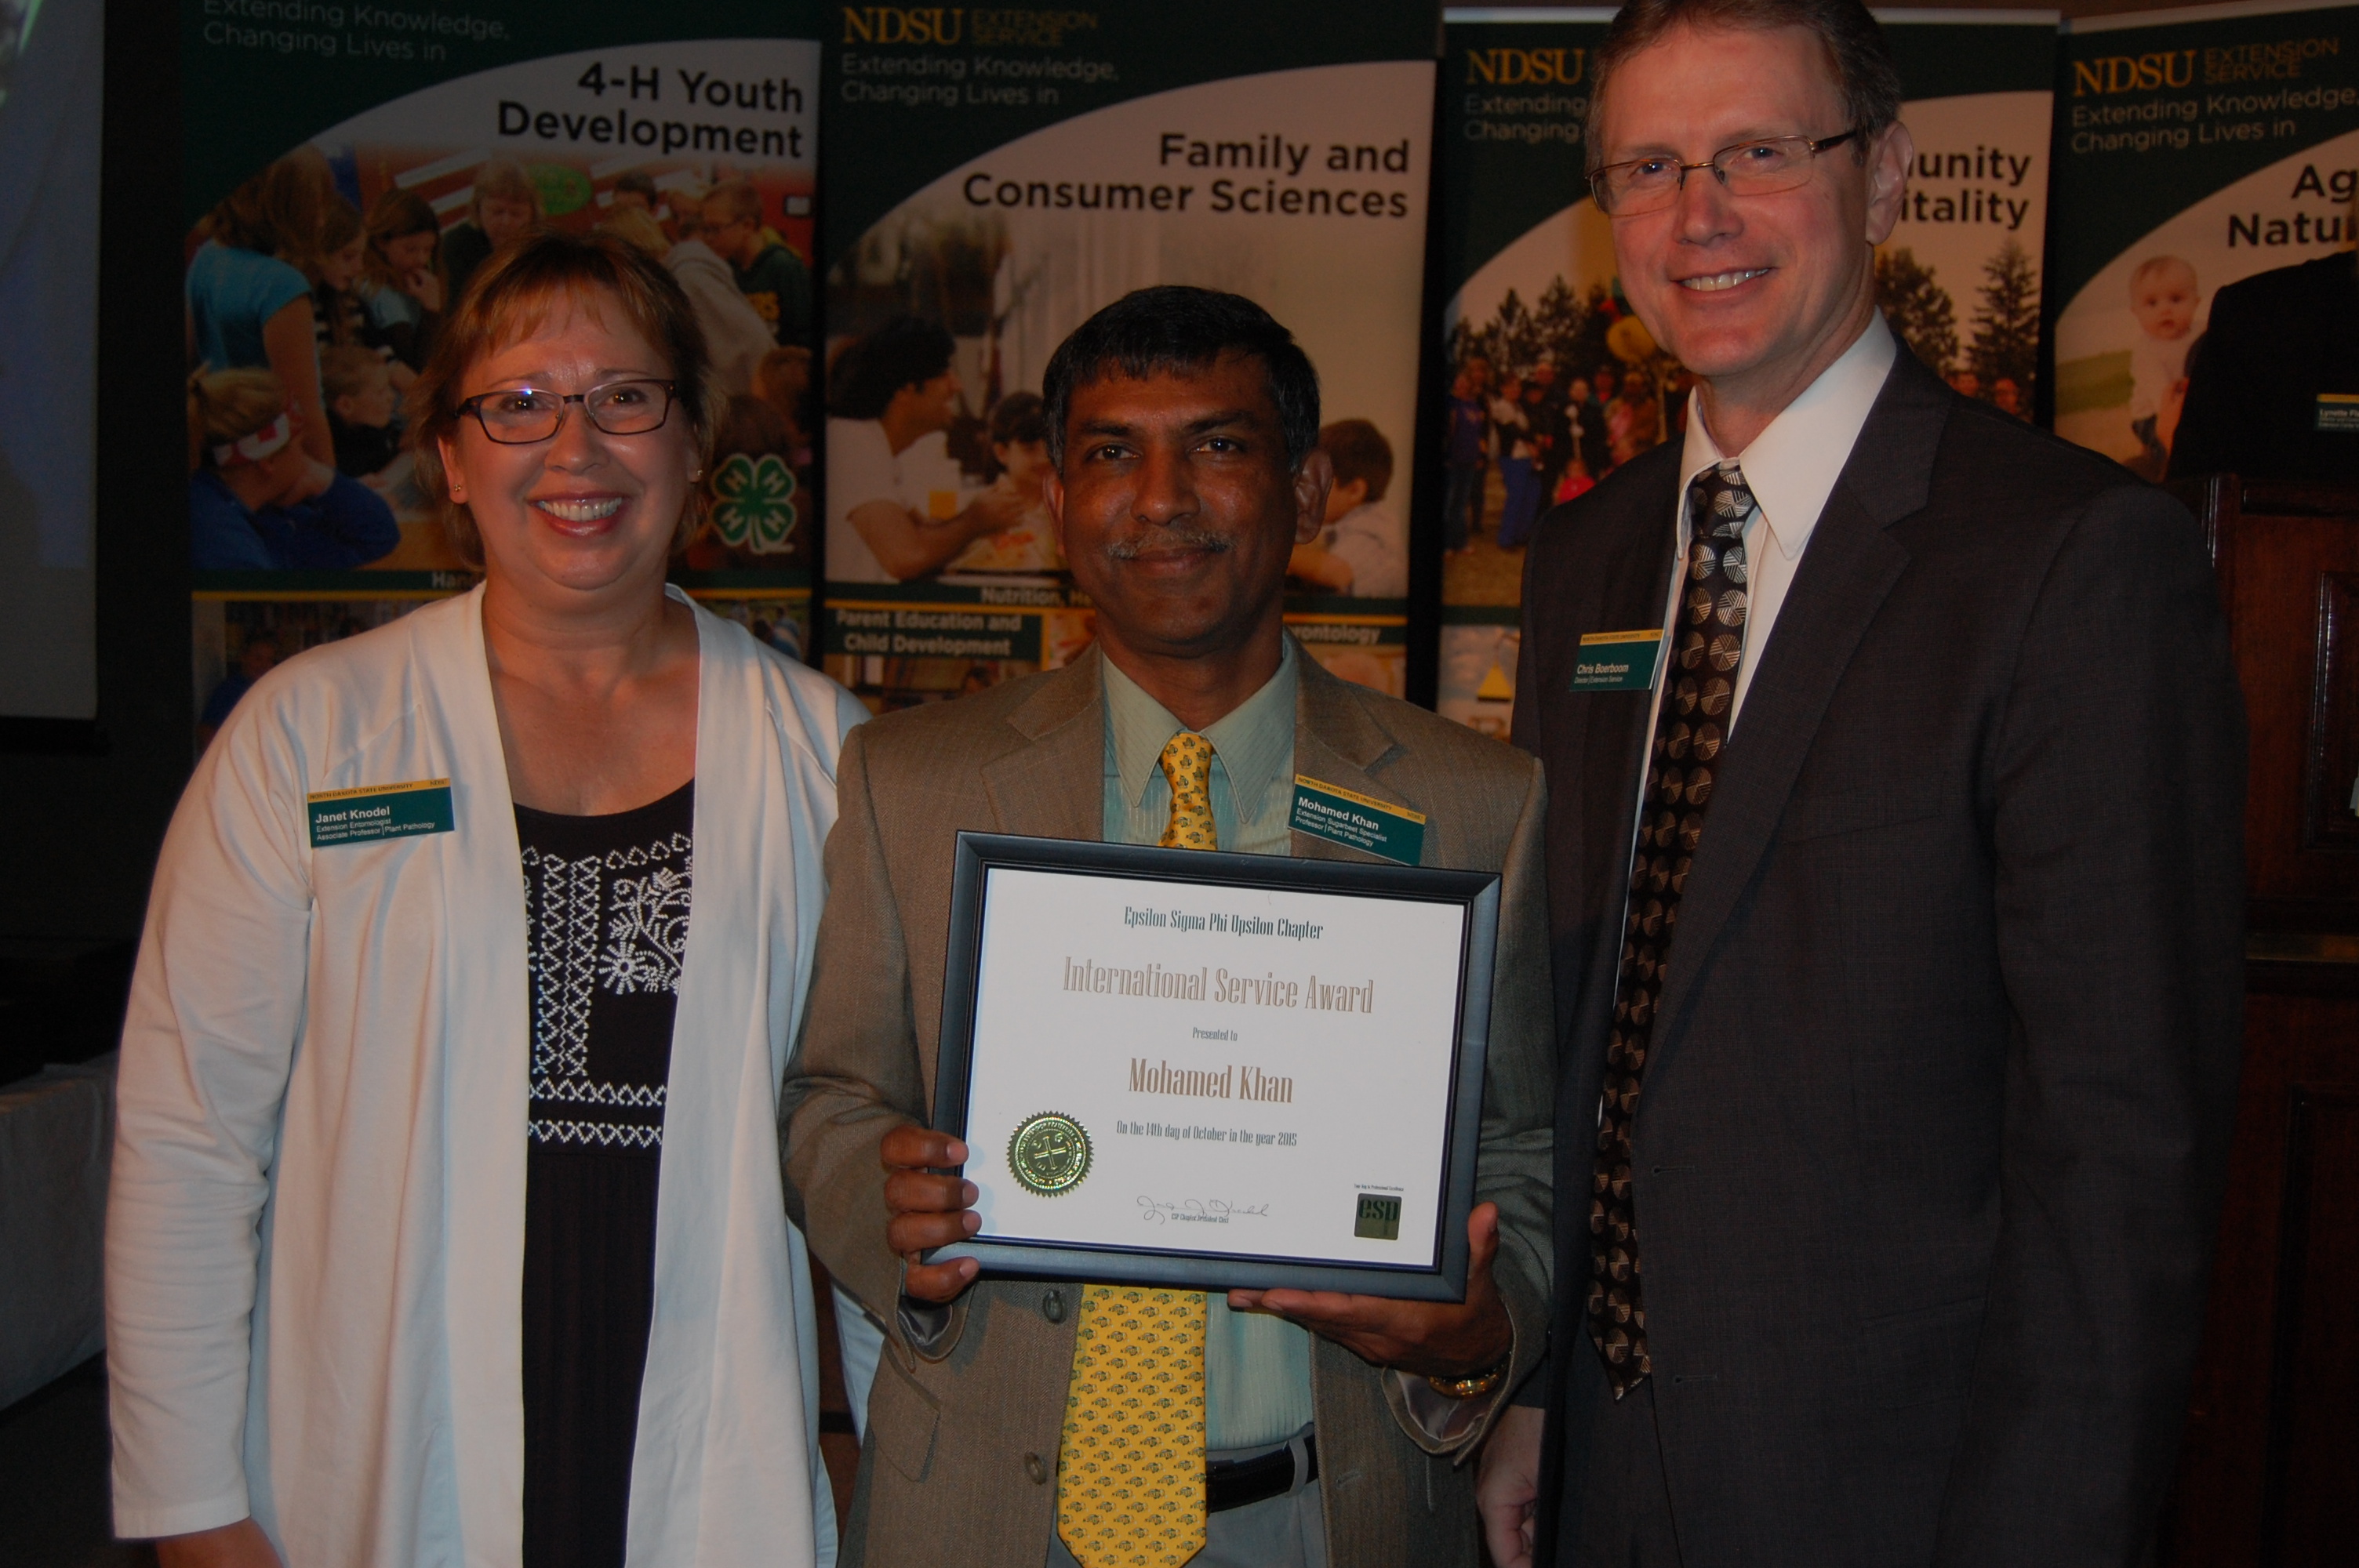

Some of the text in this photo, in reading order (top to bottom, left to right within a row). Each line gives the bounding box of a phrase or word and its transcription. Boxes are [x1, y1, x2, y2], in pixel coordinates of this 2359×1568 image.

[842, 6, 965, 45] NDSU
[203, 20, 447, 63] Changing Lives in
[841, 52, 969, 82] Extending
[1465, 47, 1586, 85] NDSU
[2071, 37, 2341, 97] NDSU EXTENSION
[2205, 60, 2302, 85] SERVICE
[577, 62, 803, 114] 4-H Youth
[841, 80, 1060, 108] Changing Lives in
[1464, 91, 1588, 118] Extending
[2070, 97, 2198, 129] Extending
[498, 100, 801, 158] Development
[1463, 118, 1580, 145] Changing
[2071, 117, 2296, 154] Changing Lives in
[1160, 133, 1409, 176] Family and
[963, 173, 1408, 219] Consumer Sciences
[836, 609, 1023, 632] Parent Education and
[844, 633, 1012, 657] Child Development
[1577, 663, 1629, 674] Chris Boerboom
[310, 790, 332, 800] NORTH
[334, 787, 357, 798] DAKOTA
[358, 784, 377, 793] STATE
[378, 783, 413, 792] UNIVERSITY
[1298, 776, 1318, 788] NORTH
[1319, 783, 1342, 795] DAKOTA
[1343, 790, 1359, 800] STATE
[315, 805, 390, 824] Janet Knodel
[316, 818, 391, 833] Extension Entomologist
[1296, 808, 1387, 843] Extension Sugarbeet Specialist
[1298, 797, 1379, 831] Mohamed Khan
[316, 832, 348, 841] Associate
[350, 828, 380, 837] Professor
[403, 822, 435, 831] Pathology
[1296, 817, 1373, 848] Professor Plant Pathology
[1125, 906, 1324, 941] Epsilon Sigma Phi Upsilon Chapter
[1063, 956, 1374, 1014] International Service Award
[1193, 1027, 1238, 1041] Presented to
[1129, 1058, 1293, 1103] Mohamed Khan
[1117, 1120, 1297, 1146] On the 14th day of October in the year 2015
[1359, 1199, 1398, 1236] esp
